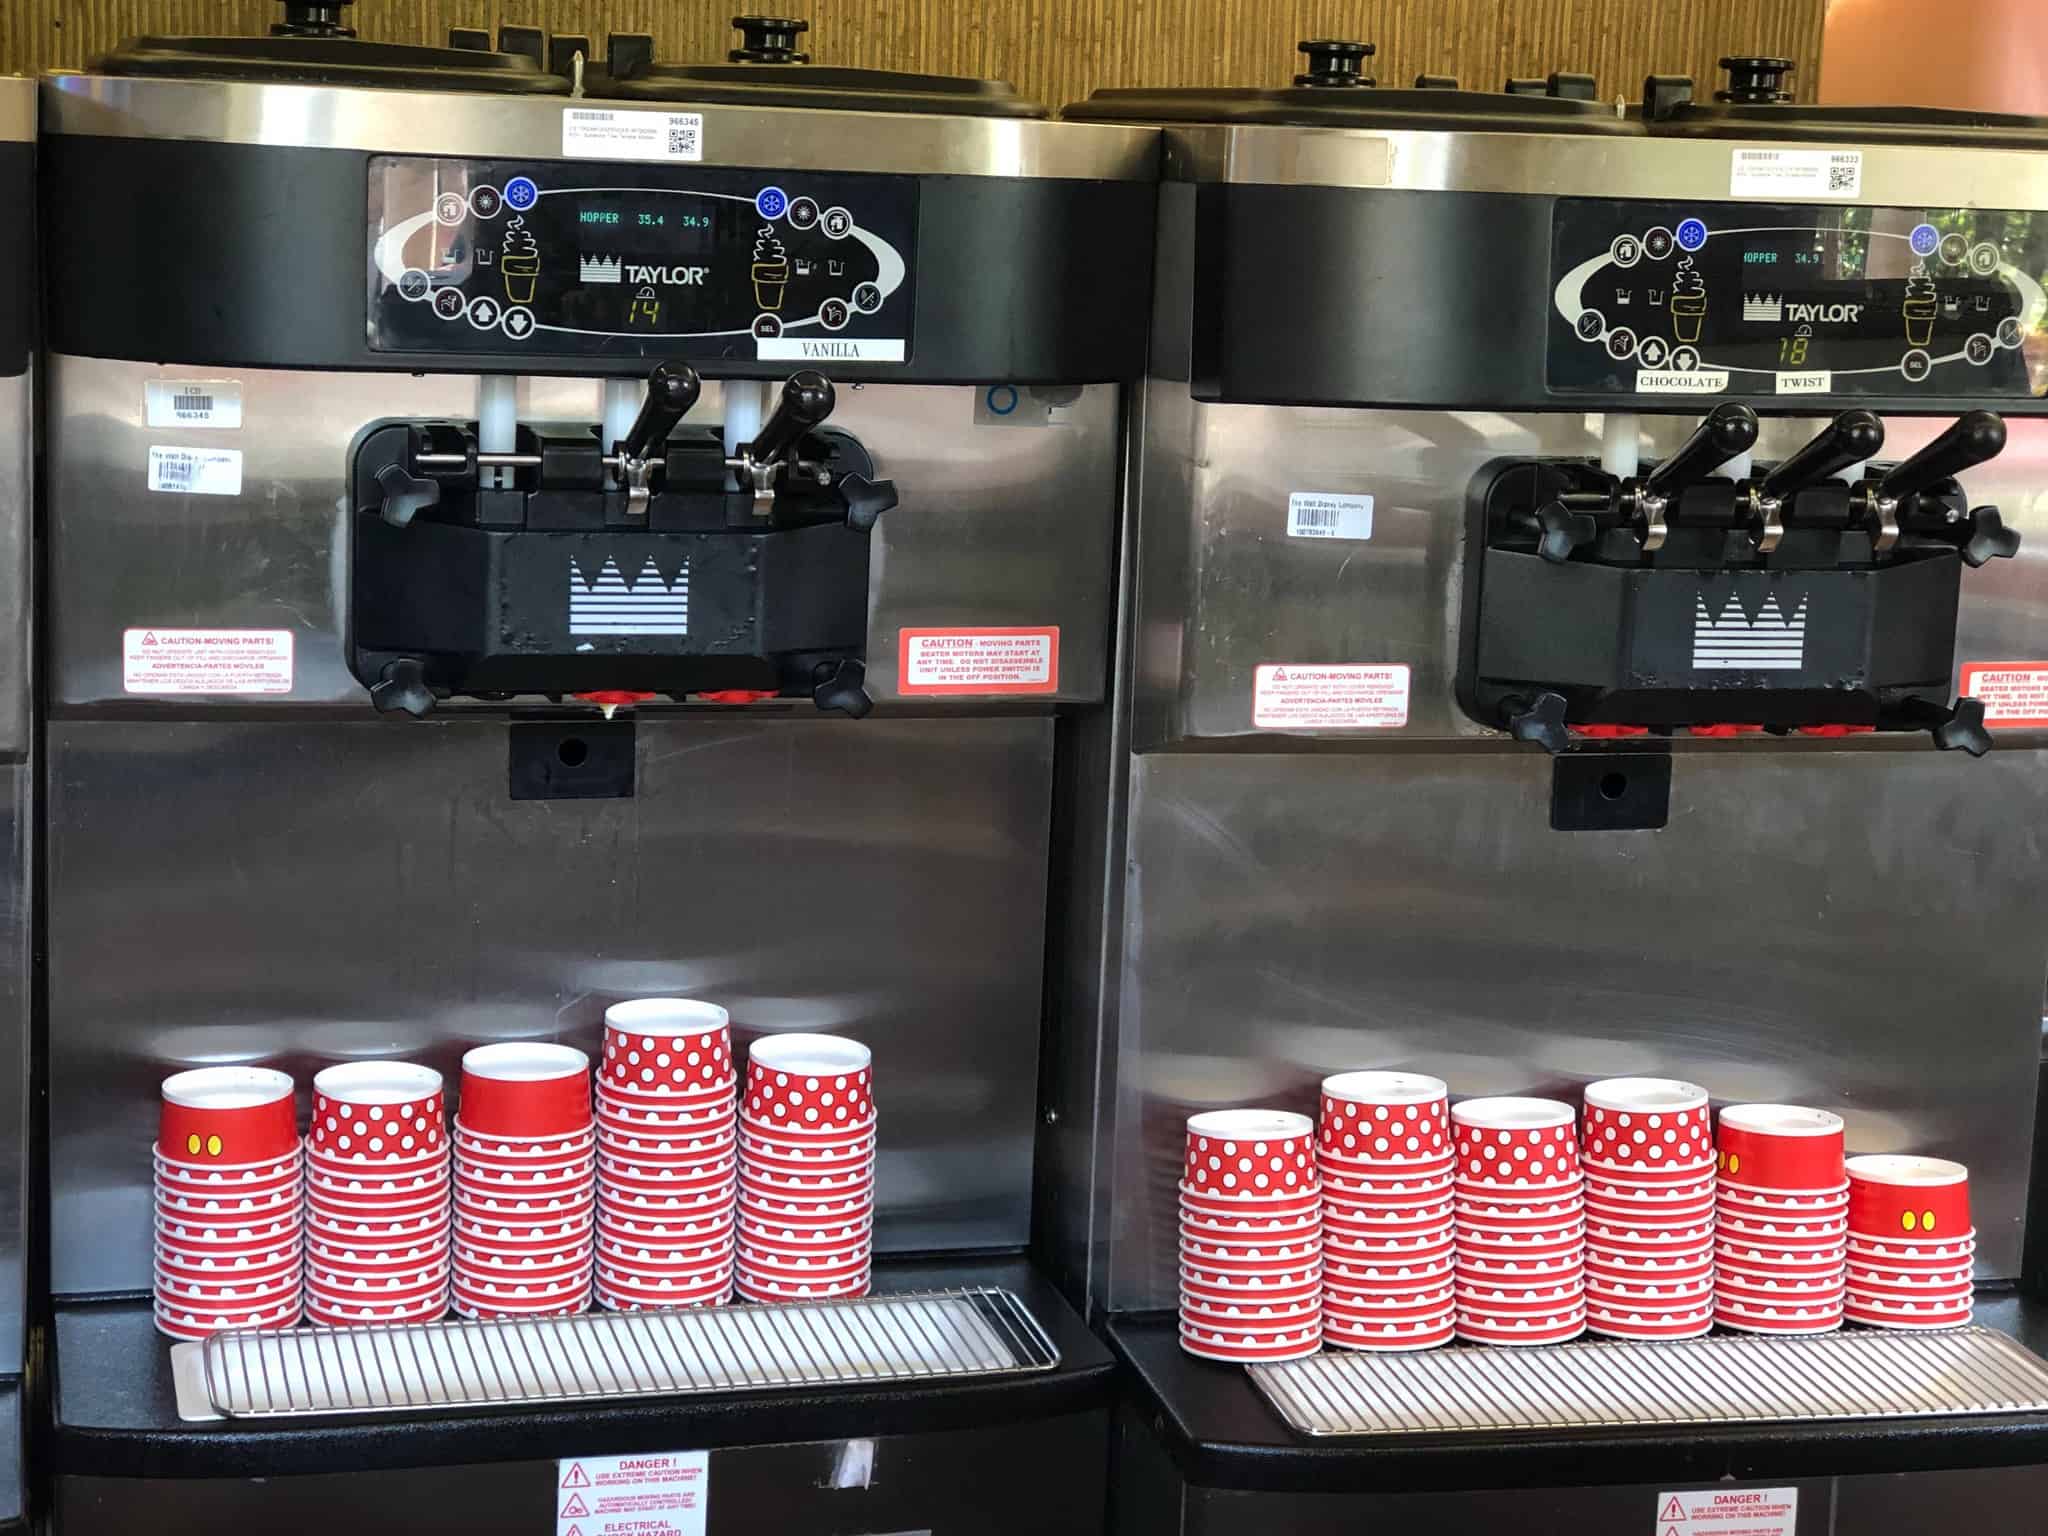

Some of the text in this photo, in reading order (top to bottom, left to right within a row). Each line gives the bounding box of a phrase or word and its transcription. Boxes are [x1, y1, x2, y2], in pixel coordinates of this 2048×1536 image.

[580, 211, 709, 227] HOPPER 35.4 34.9
[1795, 253, 1819, 264] 34.9
[625, 265, 704, 285] TAYLOR
[629, 300, 660, 325] 14
[1785, 303, 1859, 322] TAYLOR
[801, 342, 860, 358] VANILLA
[1780, 337, 1809, 365] 18
[1640, 375, 1724, 388] CHOCOLATE
[1781, 376, 1825, 388] TWIST
[922, 639, 973, 648] CAUTION
[1982, 673, 2031, 682] CAUTION
[619, 1458, 670, 1471] DANGER
[1714, 1494, 1761, 1505] DANGER
[605, 1520, 671, 1532] ELECTRICAL
